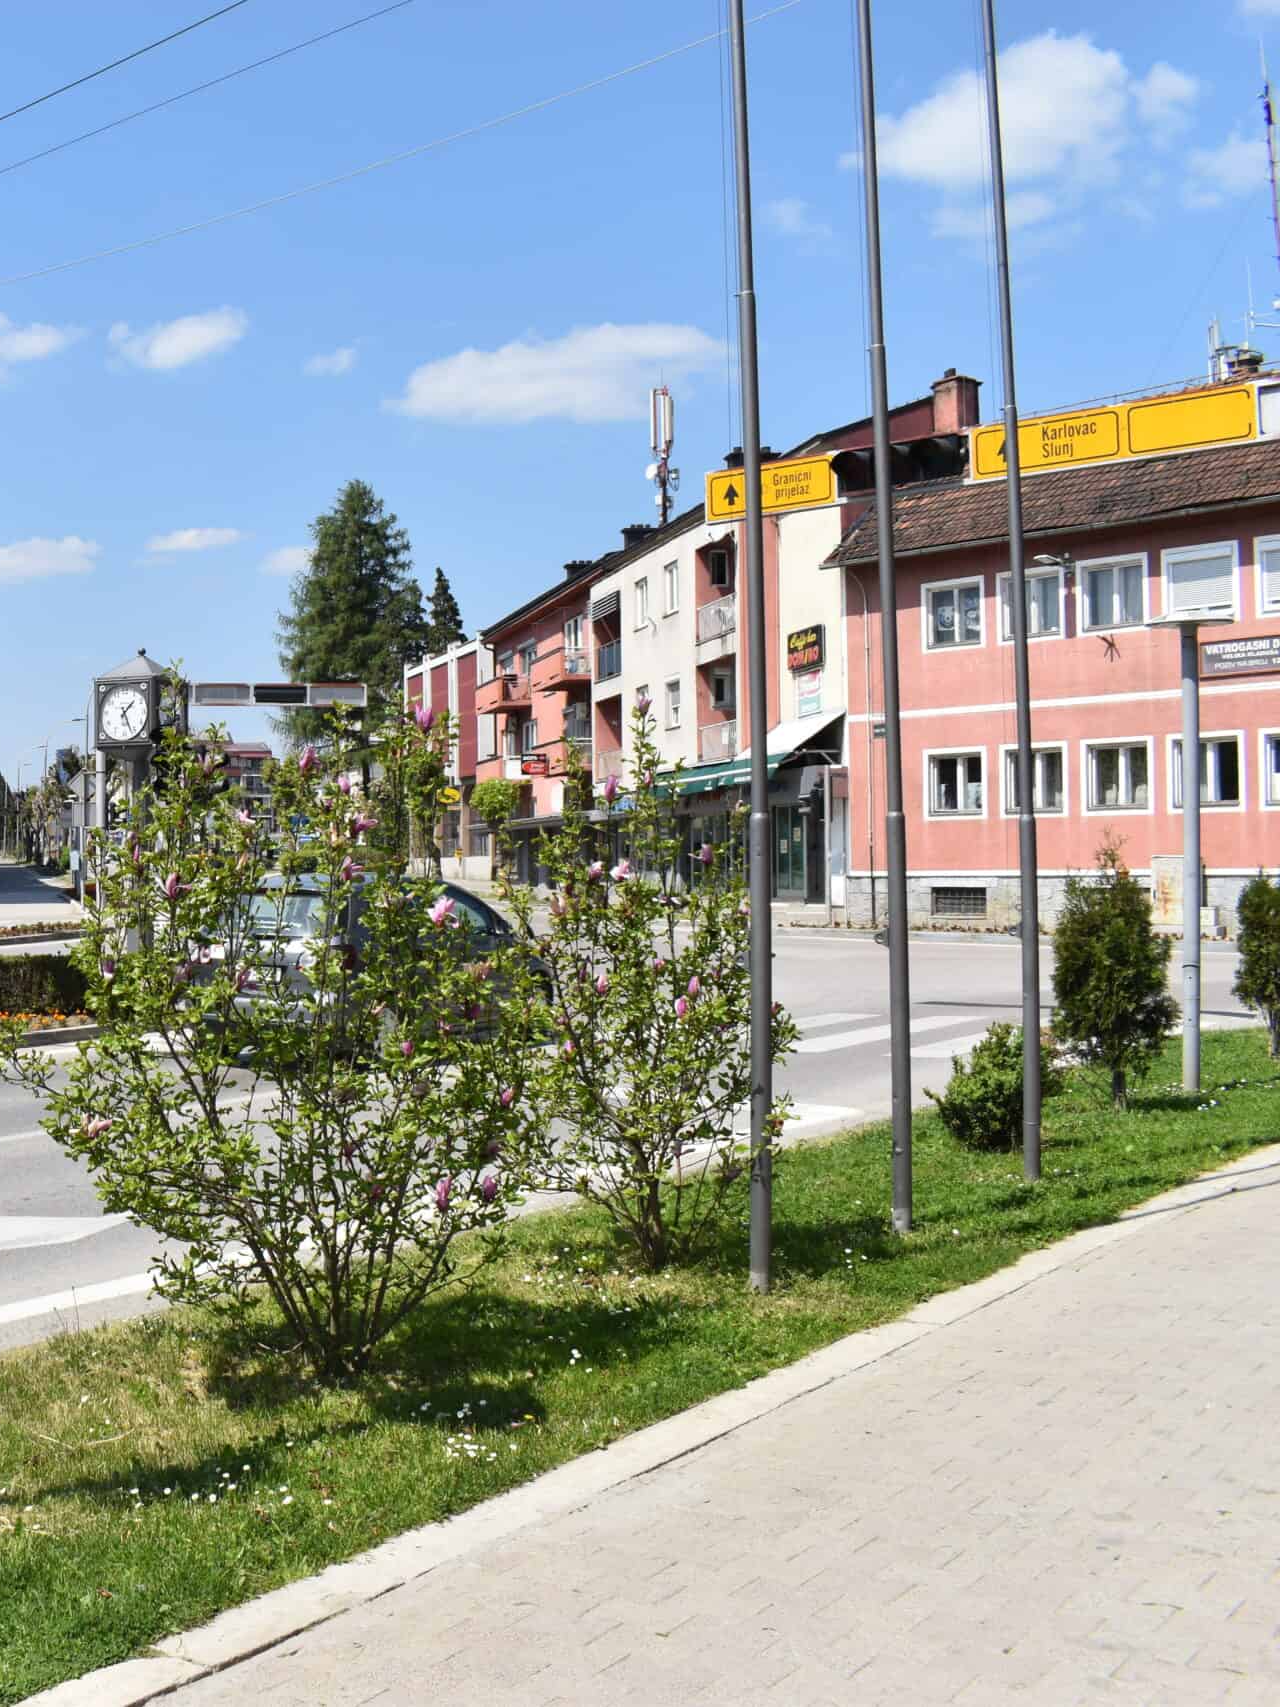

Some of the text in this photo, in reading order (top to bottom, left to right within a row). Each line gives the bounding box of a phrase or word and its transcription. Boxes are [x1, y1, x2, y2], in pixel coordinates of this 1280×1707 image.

[1042, 422, 1096, 441] Karlovac
[1042, 439, 1074, 458] Slunj
[775, 484, 809, 502] prijelaz
